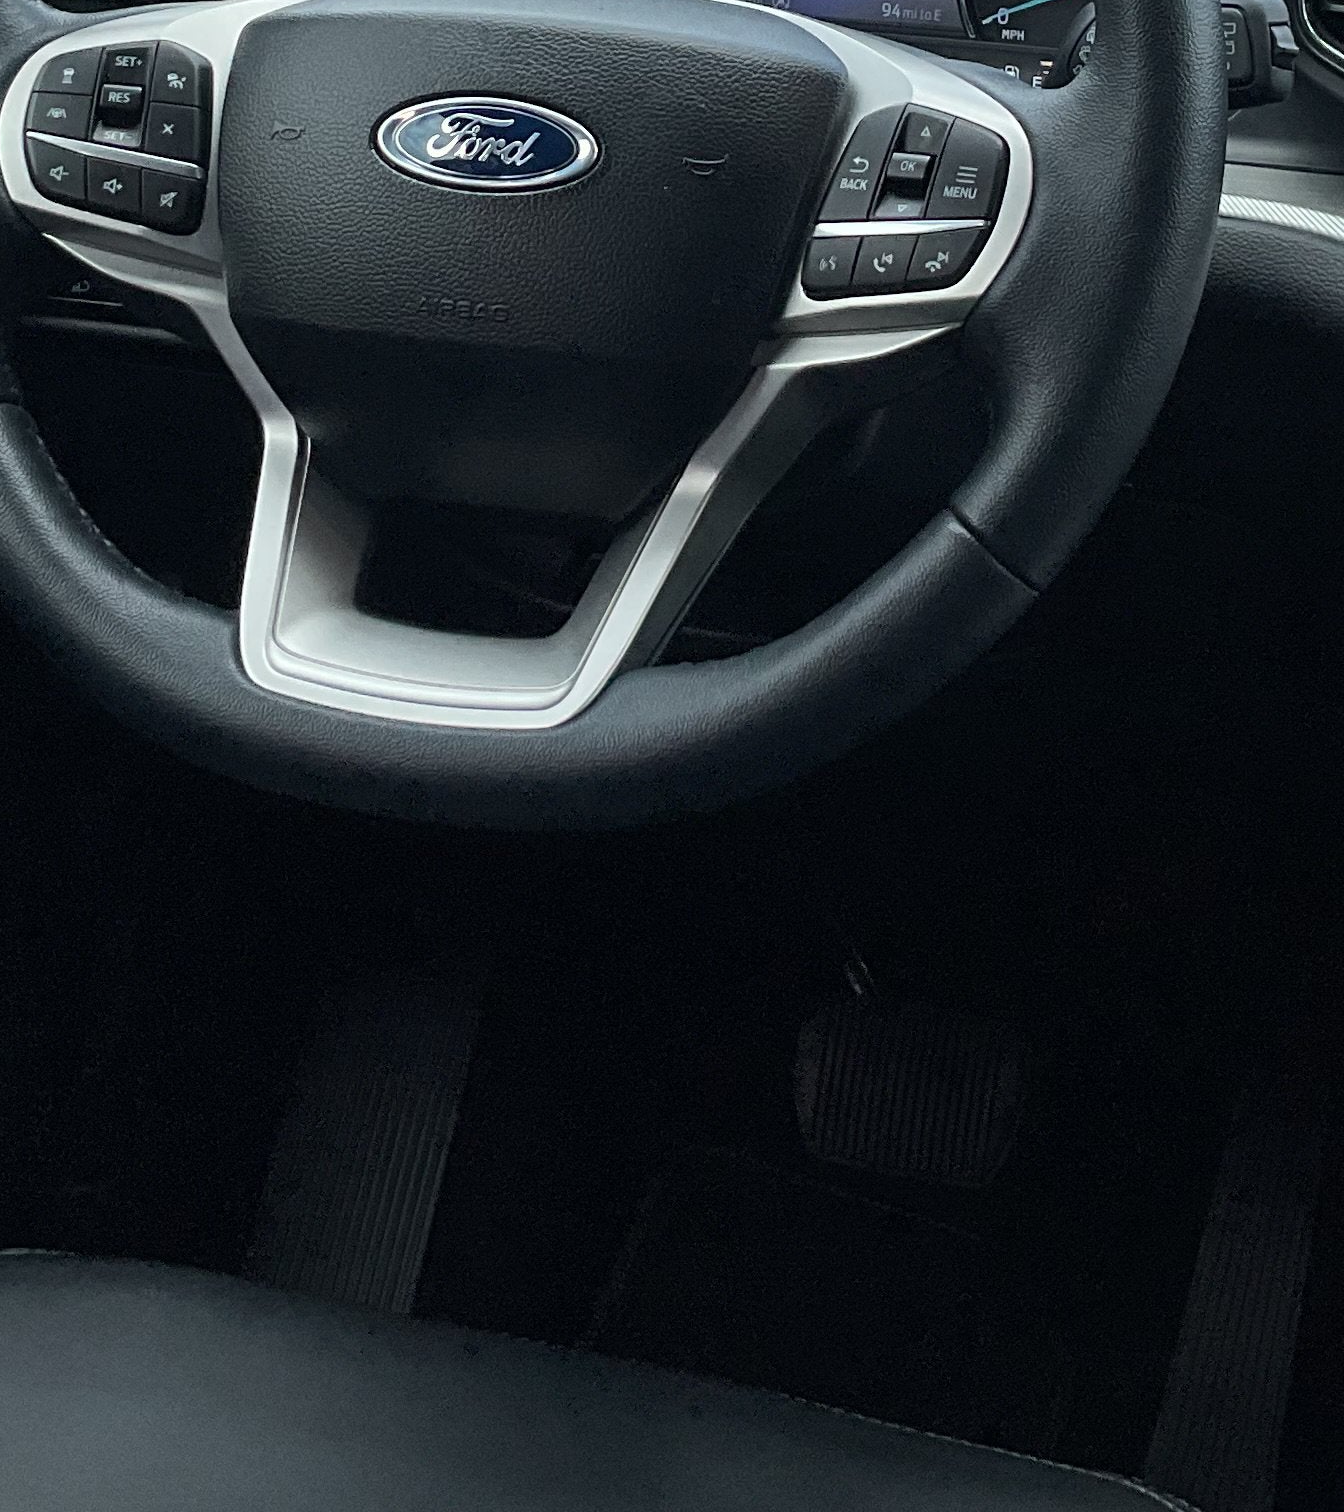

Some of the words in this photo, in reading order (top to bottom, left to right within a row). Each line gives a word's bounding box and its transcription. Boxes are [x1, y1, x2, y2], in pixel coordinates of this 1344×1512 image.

[881, 2, 901, 18] 94
[902, 7, 918, 19] mi
[997, 8, 1009, 25] 0
[1001, 29, 1025, 41] MPH
[108, 91, 130, 103] RES
[426, 112, 541, 167] Ford
[900, 160, 916, 172] OK
[839, 177, 869, 191] BACK
[942, 185, 978, 200] MENU
[416, 295, 510, 323] AIRBAG
